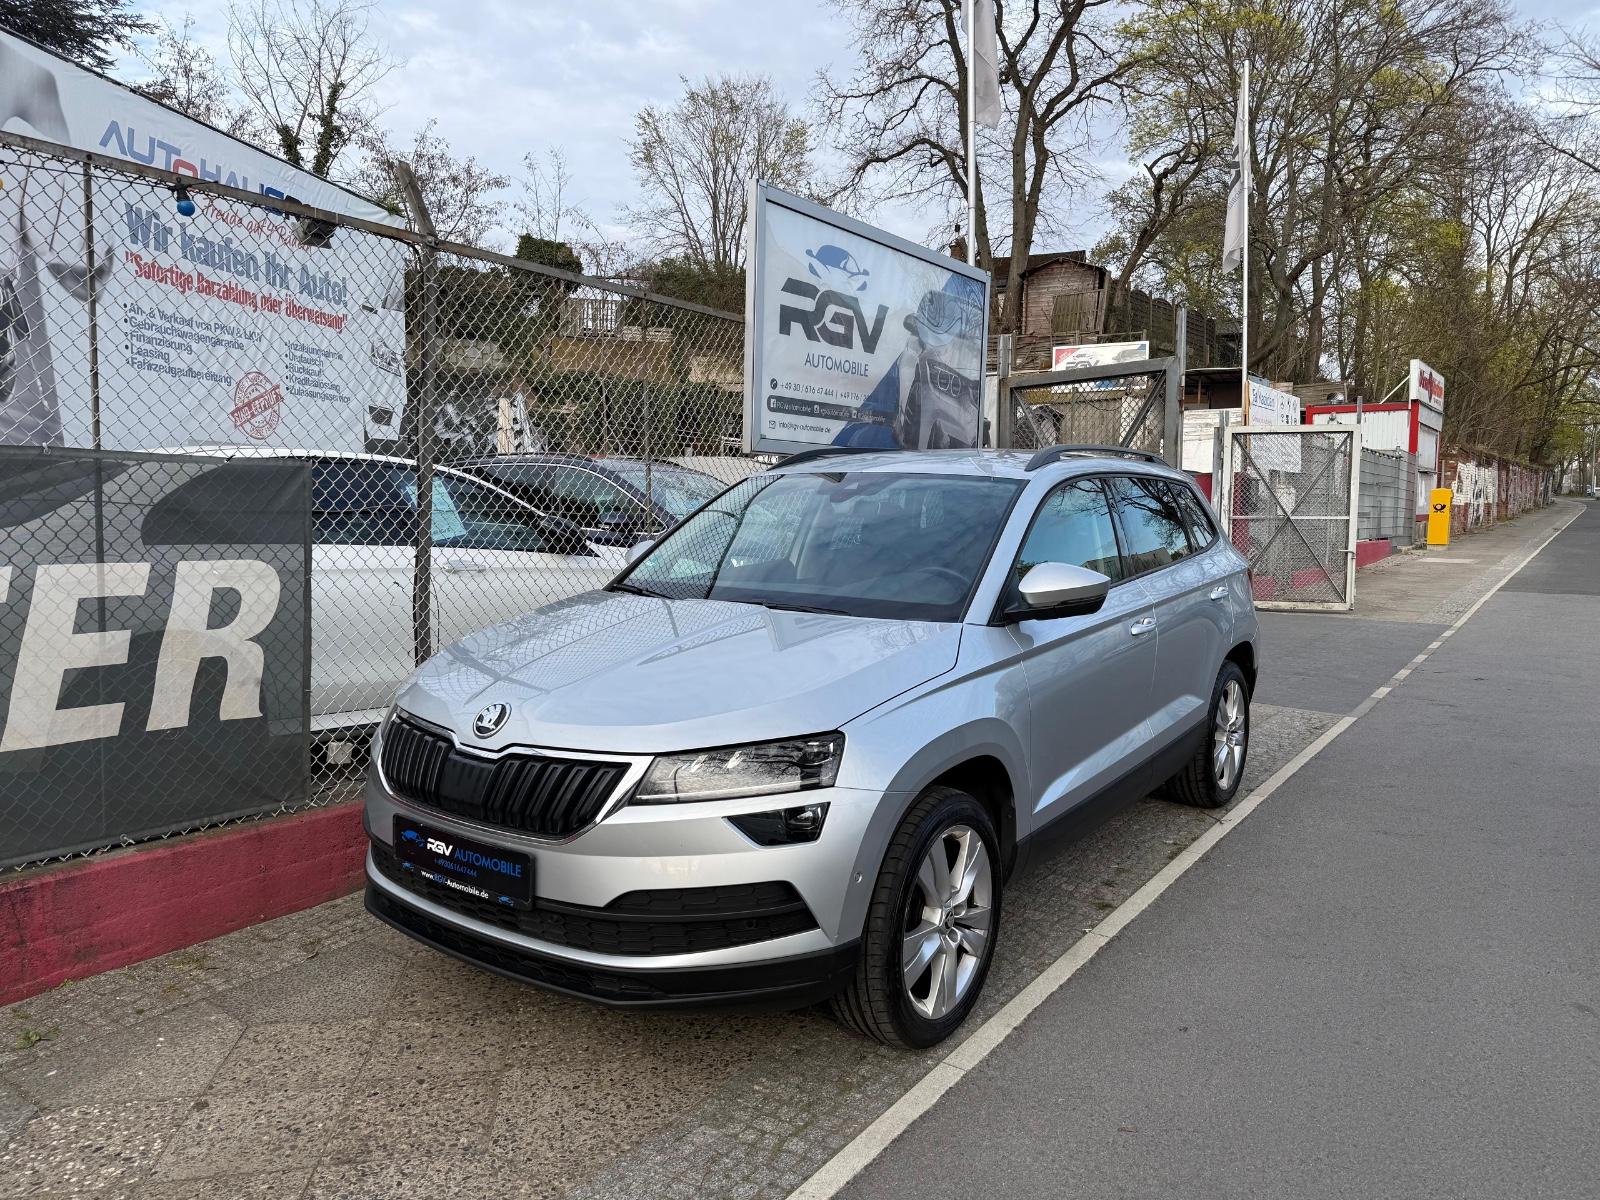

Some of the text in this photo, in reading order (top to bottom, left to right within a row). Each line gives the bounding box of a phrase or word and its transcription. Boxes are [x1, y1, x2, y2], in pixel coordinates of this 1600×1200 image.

[203, 197, 242, 228] Freude
[247, 219, 266, 240] auf
[125, 203, 347, 307] Wir kaufen Ihr Auto!
[197, 272, 257, 313] Barzahlung
[261, 293, 282, 313] oder
[157, 308, 193, 328] Verkauf
[196, 321, 212, 332] von
[214, 322, 235, 337] PKW
[244, 330, 262, 343] LKW
[779, 277, 889, 354] RGV
[130, 330, 192, 355] Finanzierung
[131, 343, 170, 362] Leasing
[131, 357, 232, 386] Fahrzeugaufbereitung
[804, 352, 869, 378] AUTOMOBILE
[793, 383, 801, 392] 30
[805, 385, 815, 394] 616
[825, 388, 834, 397] 444
[0, 558, 281, 752] ER
[427, 838, 522, 877] RGV AUTOMOBILE
[421, 870, 488, 899] www.RGV-Automobile.de
